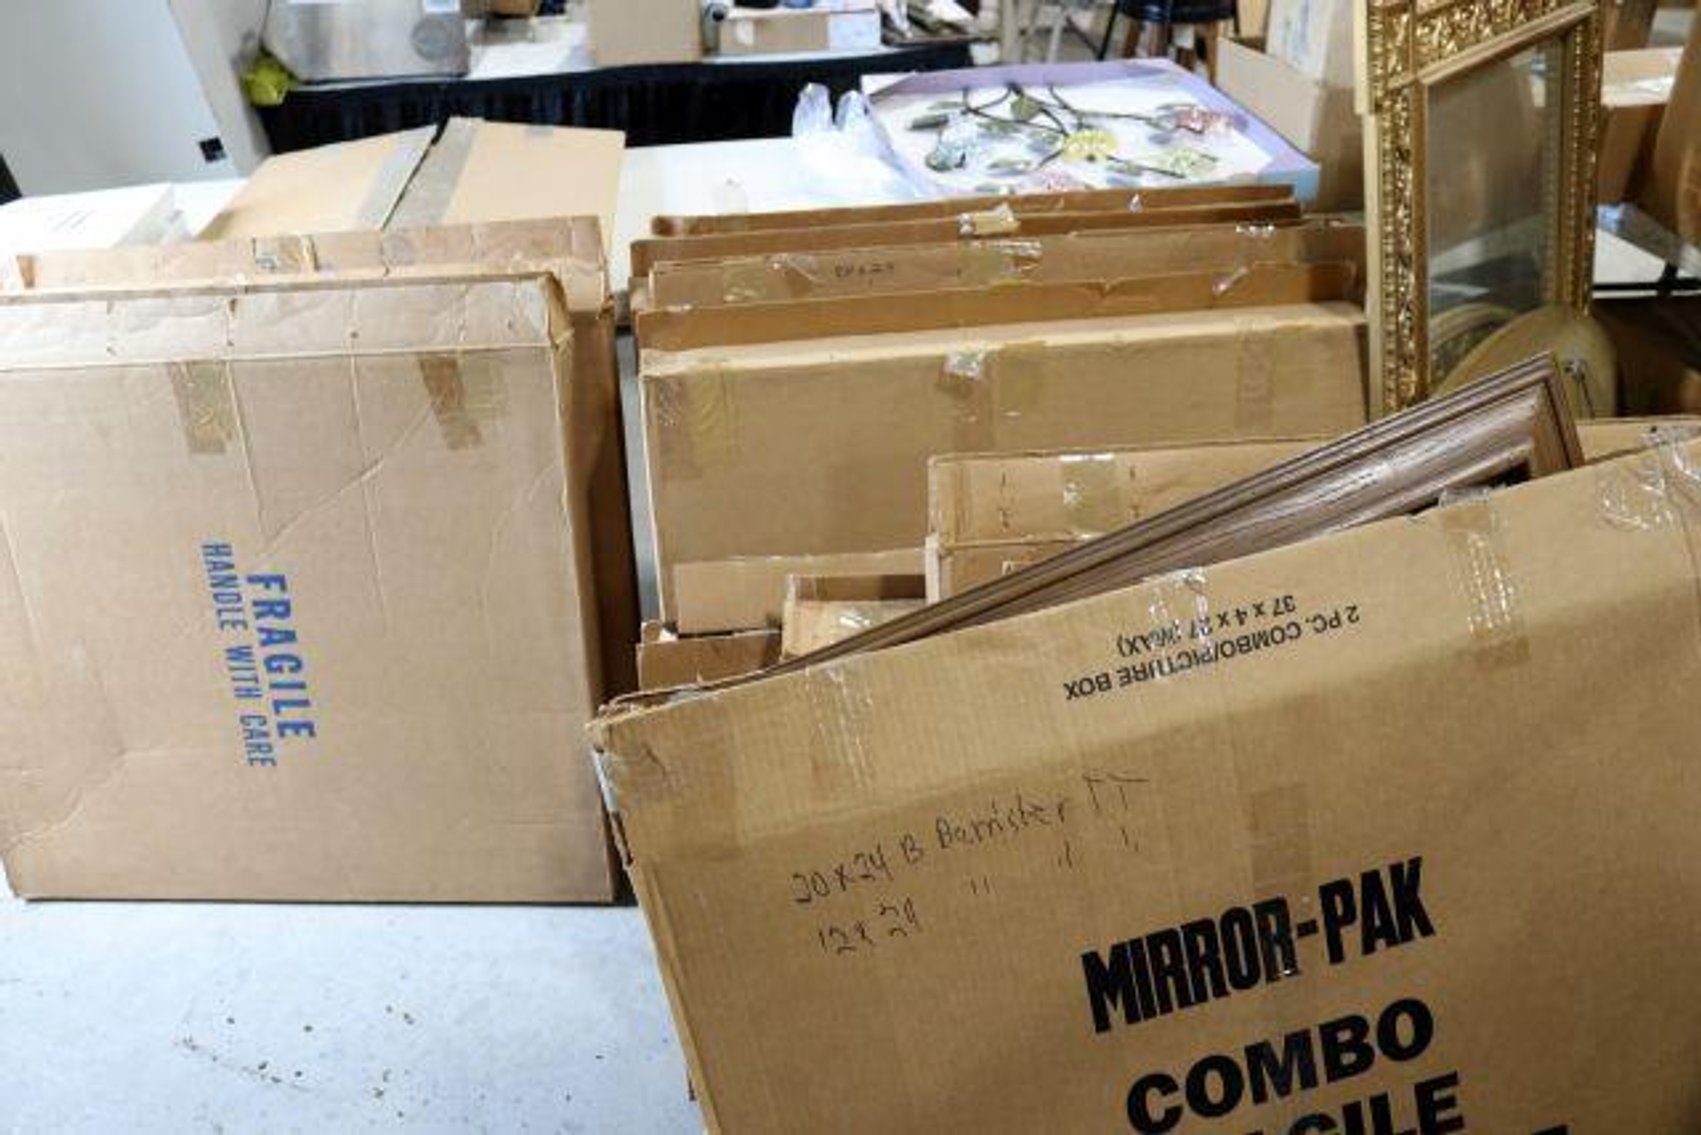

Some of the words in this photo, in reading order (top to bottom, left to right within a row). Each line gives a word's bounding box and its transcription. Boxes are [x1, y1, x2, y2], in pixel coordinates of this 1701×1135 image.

[202, 543, 249, 632] HANDLE
[1272, 594, 1297, 617] 37
[1346, 604, 1360, 624] 2
[1235, 606, 1249, 627] 4
[1305, 607, 1342, 634] PC.
[225, 644, 263, 699] WITH
[247, 573, 317, 737] FRAGILE
[1115, 620, 1302, 689] COMBO/PICTURE
[1063, 672, 1113, 701] BOX
[239, 714, 278, 768] CARE
[1081, 856, 1436, 1034] MIRROR-PAK
[1126, 997, 1435, 1135] COMBO
